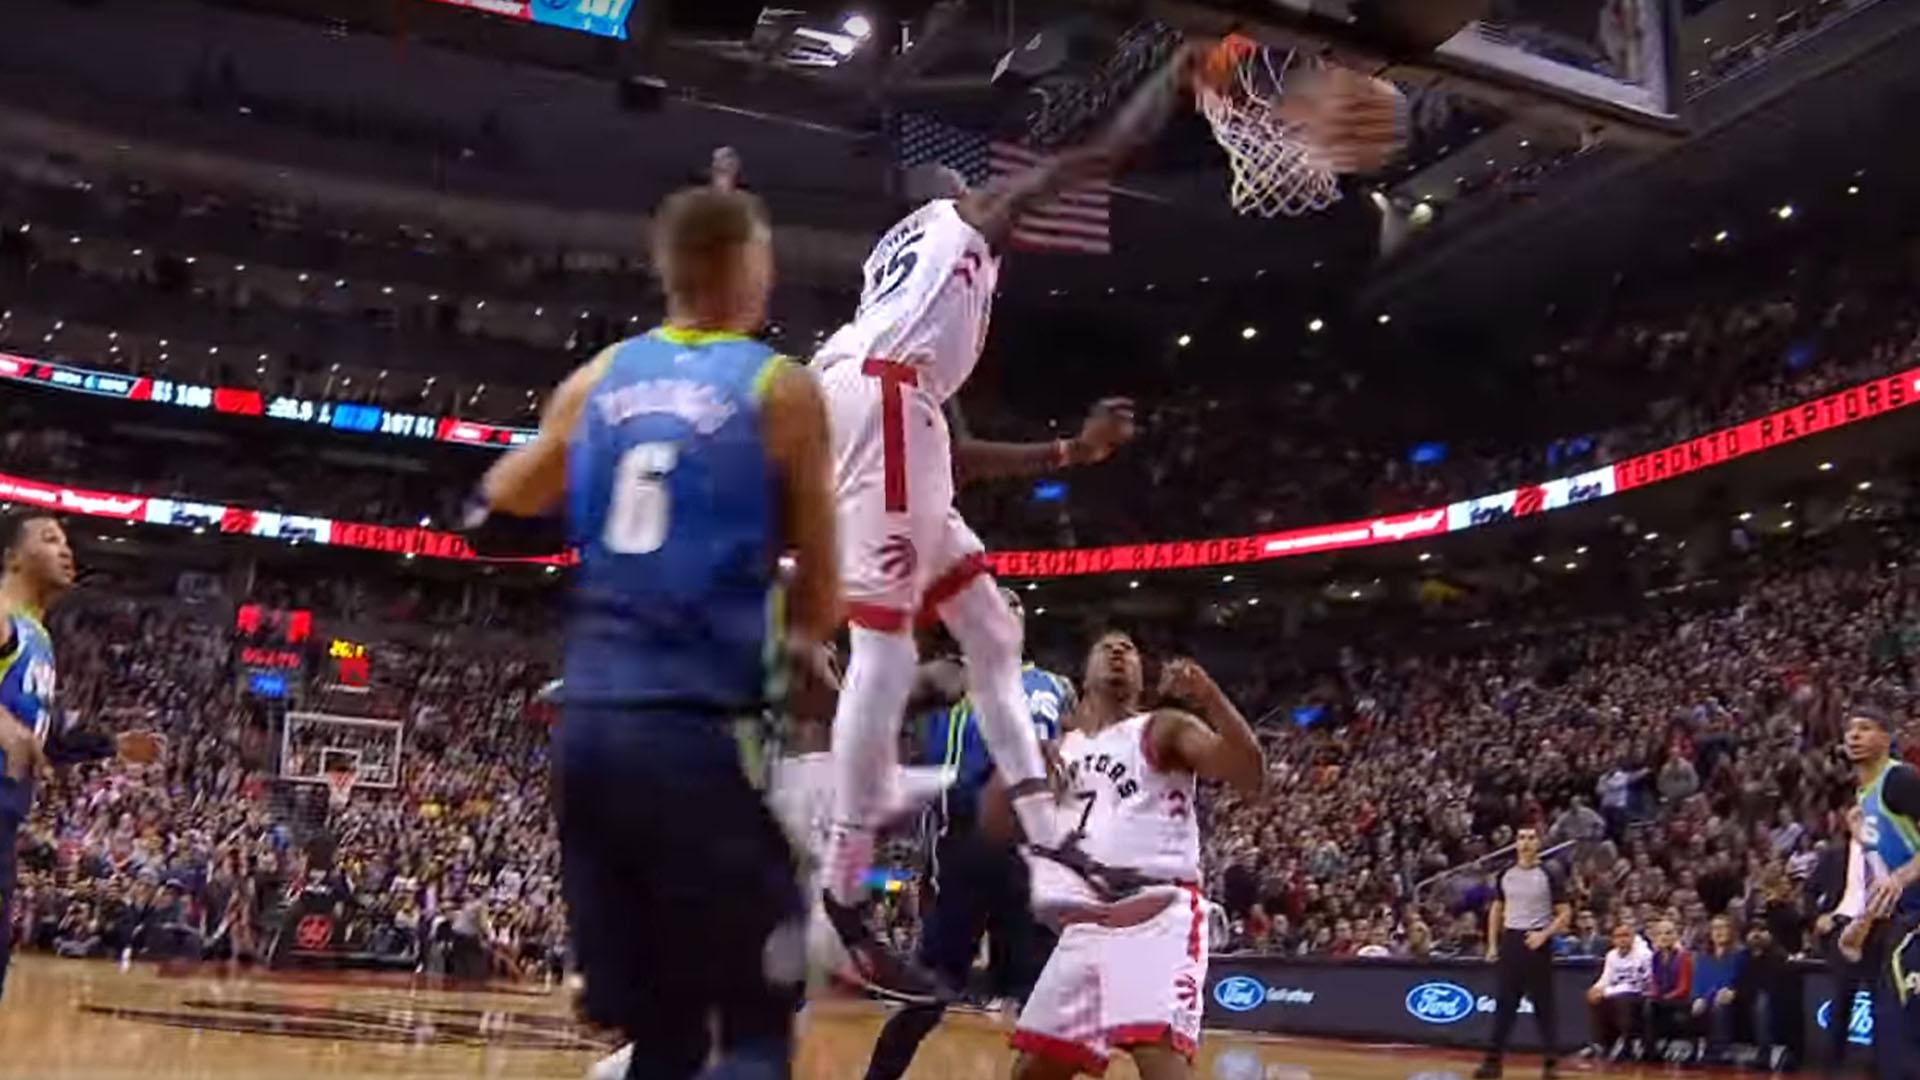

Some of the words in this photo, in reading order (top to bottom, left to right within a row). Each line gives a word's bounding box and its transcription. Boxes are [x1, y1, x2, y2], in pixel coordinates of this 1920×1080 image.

[1617, 430, 1738, 485] TORONTO
[1761, 378, 1906, 448] RAPTORS
[603, 440, 681, 554] 6
